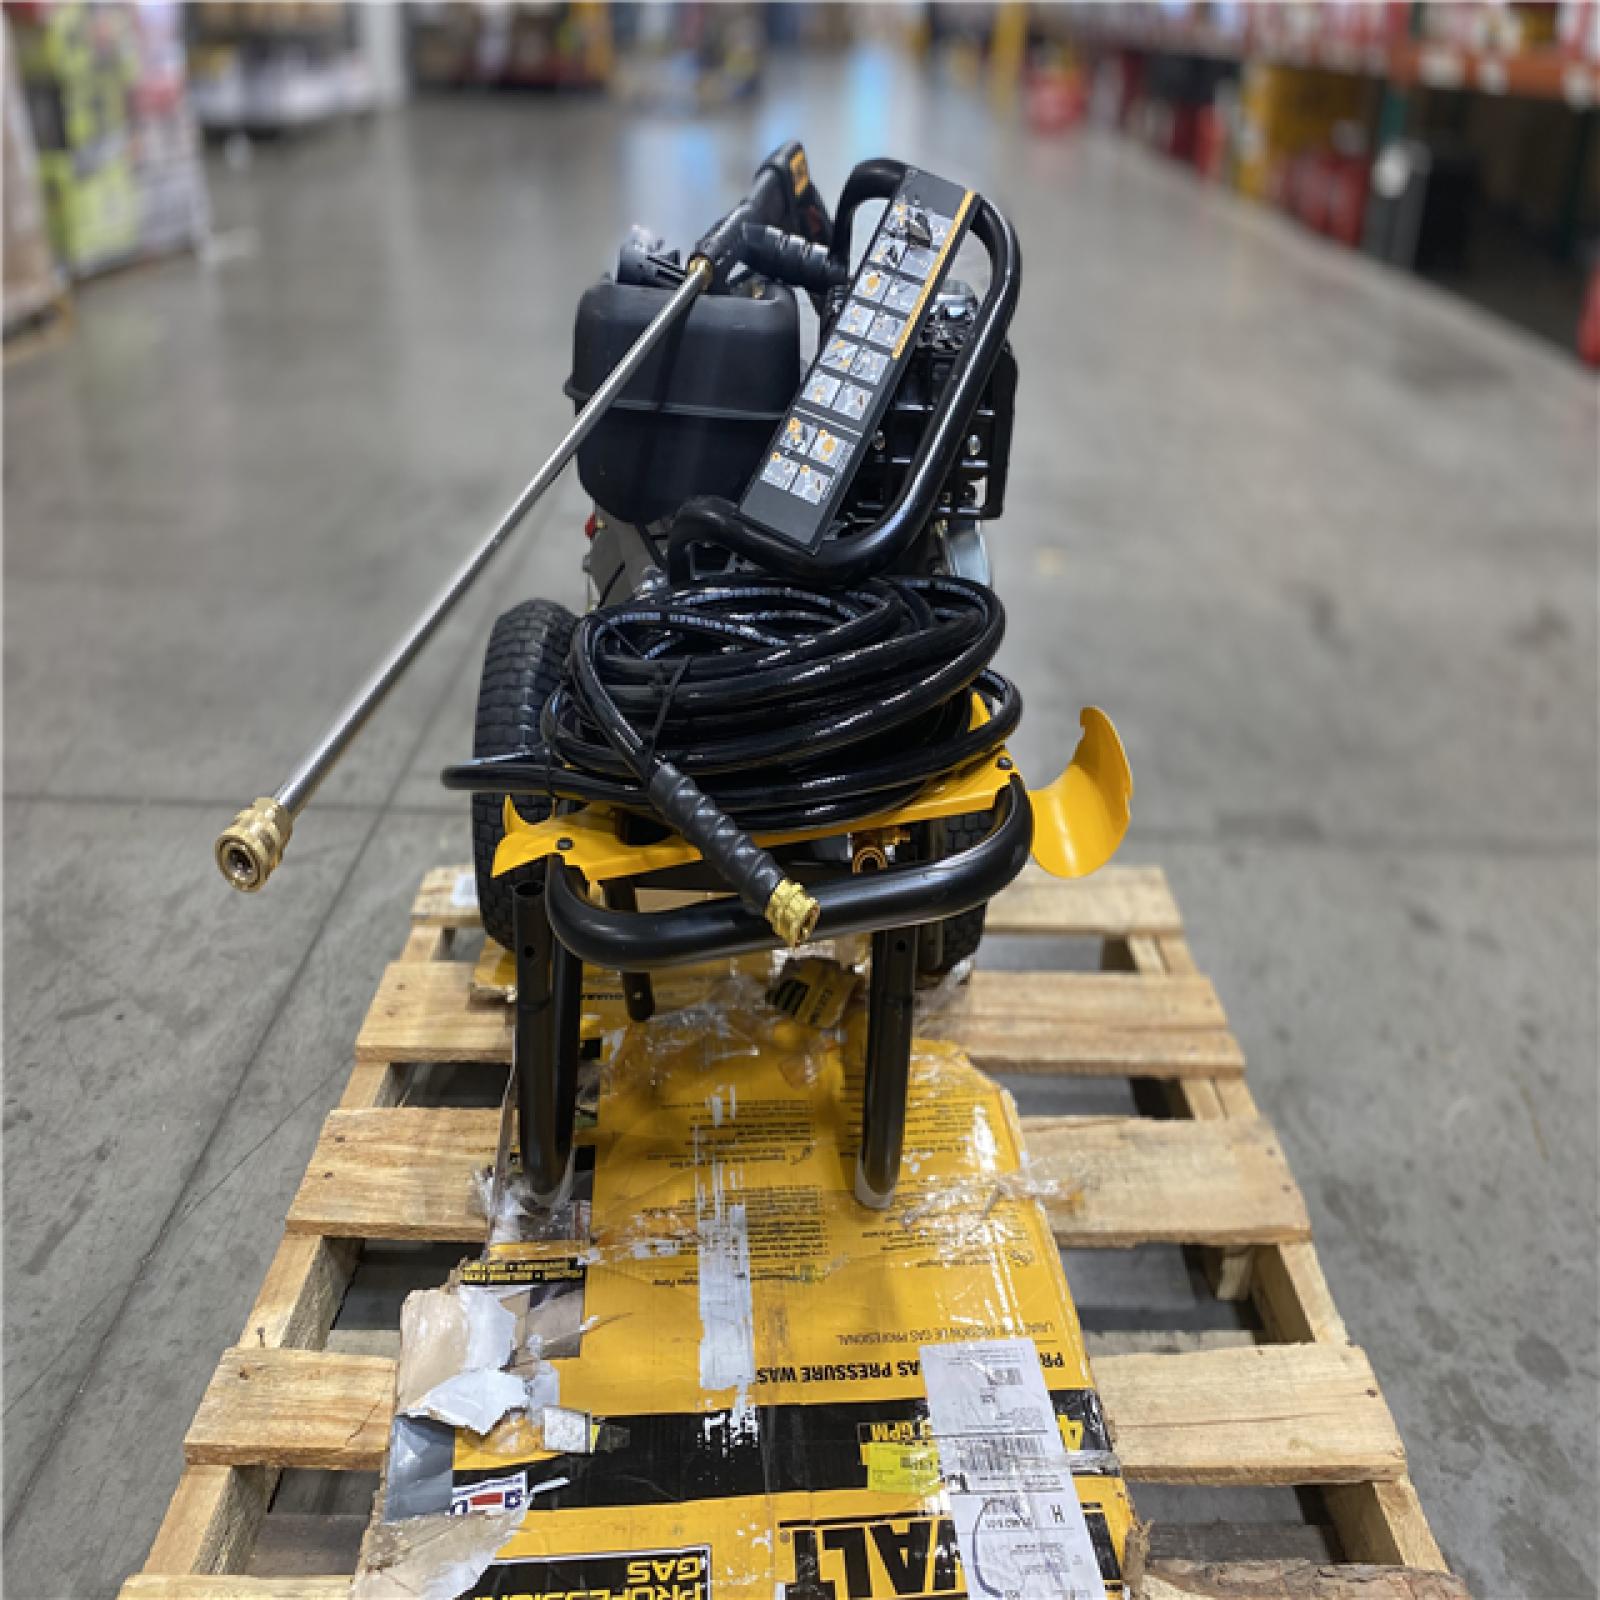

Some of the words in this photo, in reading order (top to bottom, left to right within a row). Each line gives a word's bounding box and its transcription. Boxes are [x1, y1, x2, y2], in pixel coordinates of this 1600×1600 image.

[755, 1367, 797, 1386] WAS
[801, 1362, 891, 1382] PRESSURE
[897, 1360, 920, 1377] AS
[627, 1557, 700, 1583] GAS
